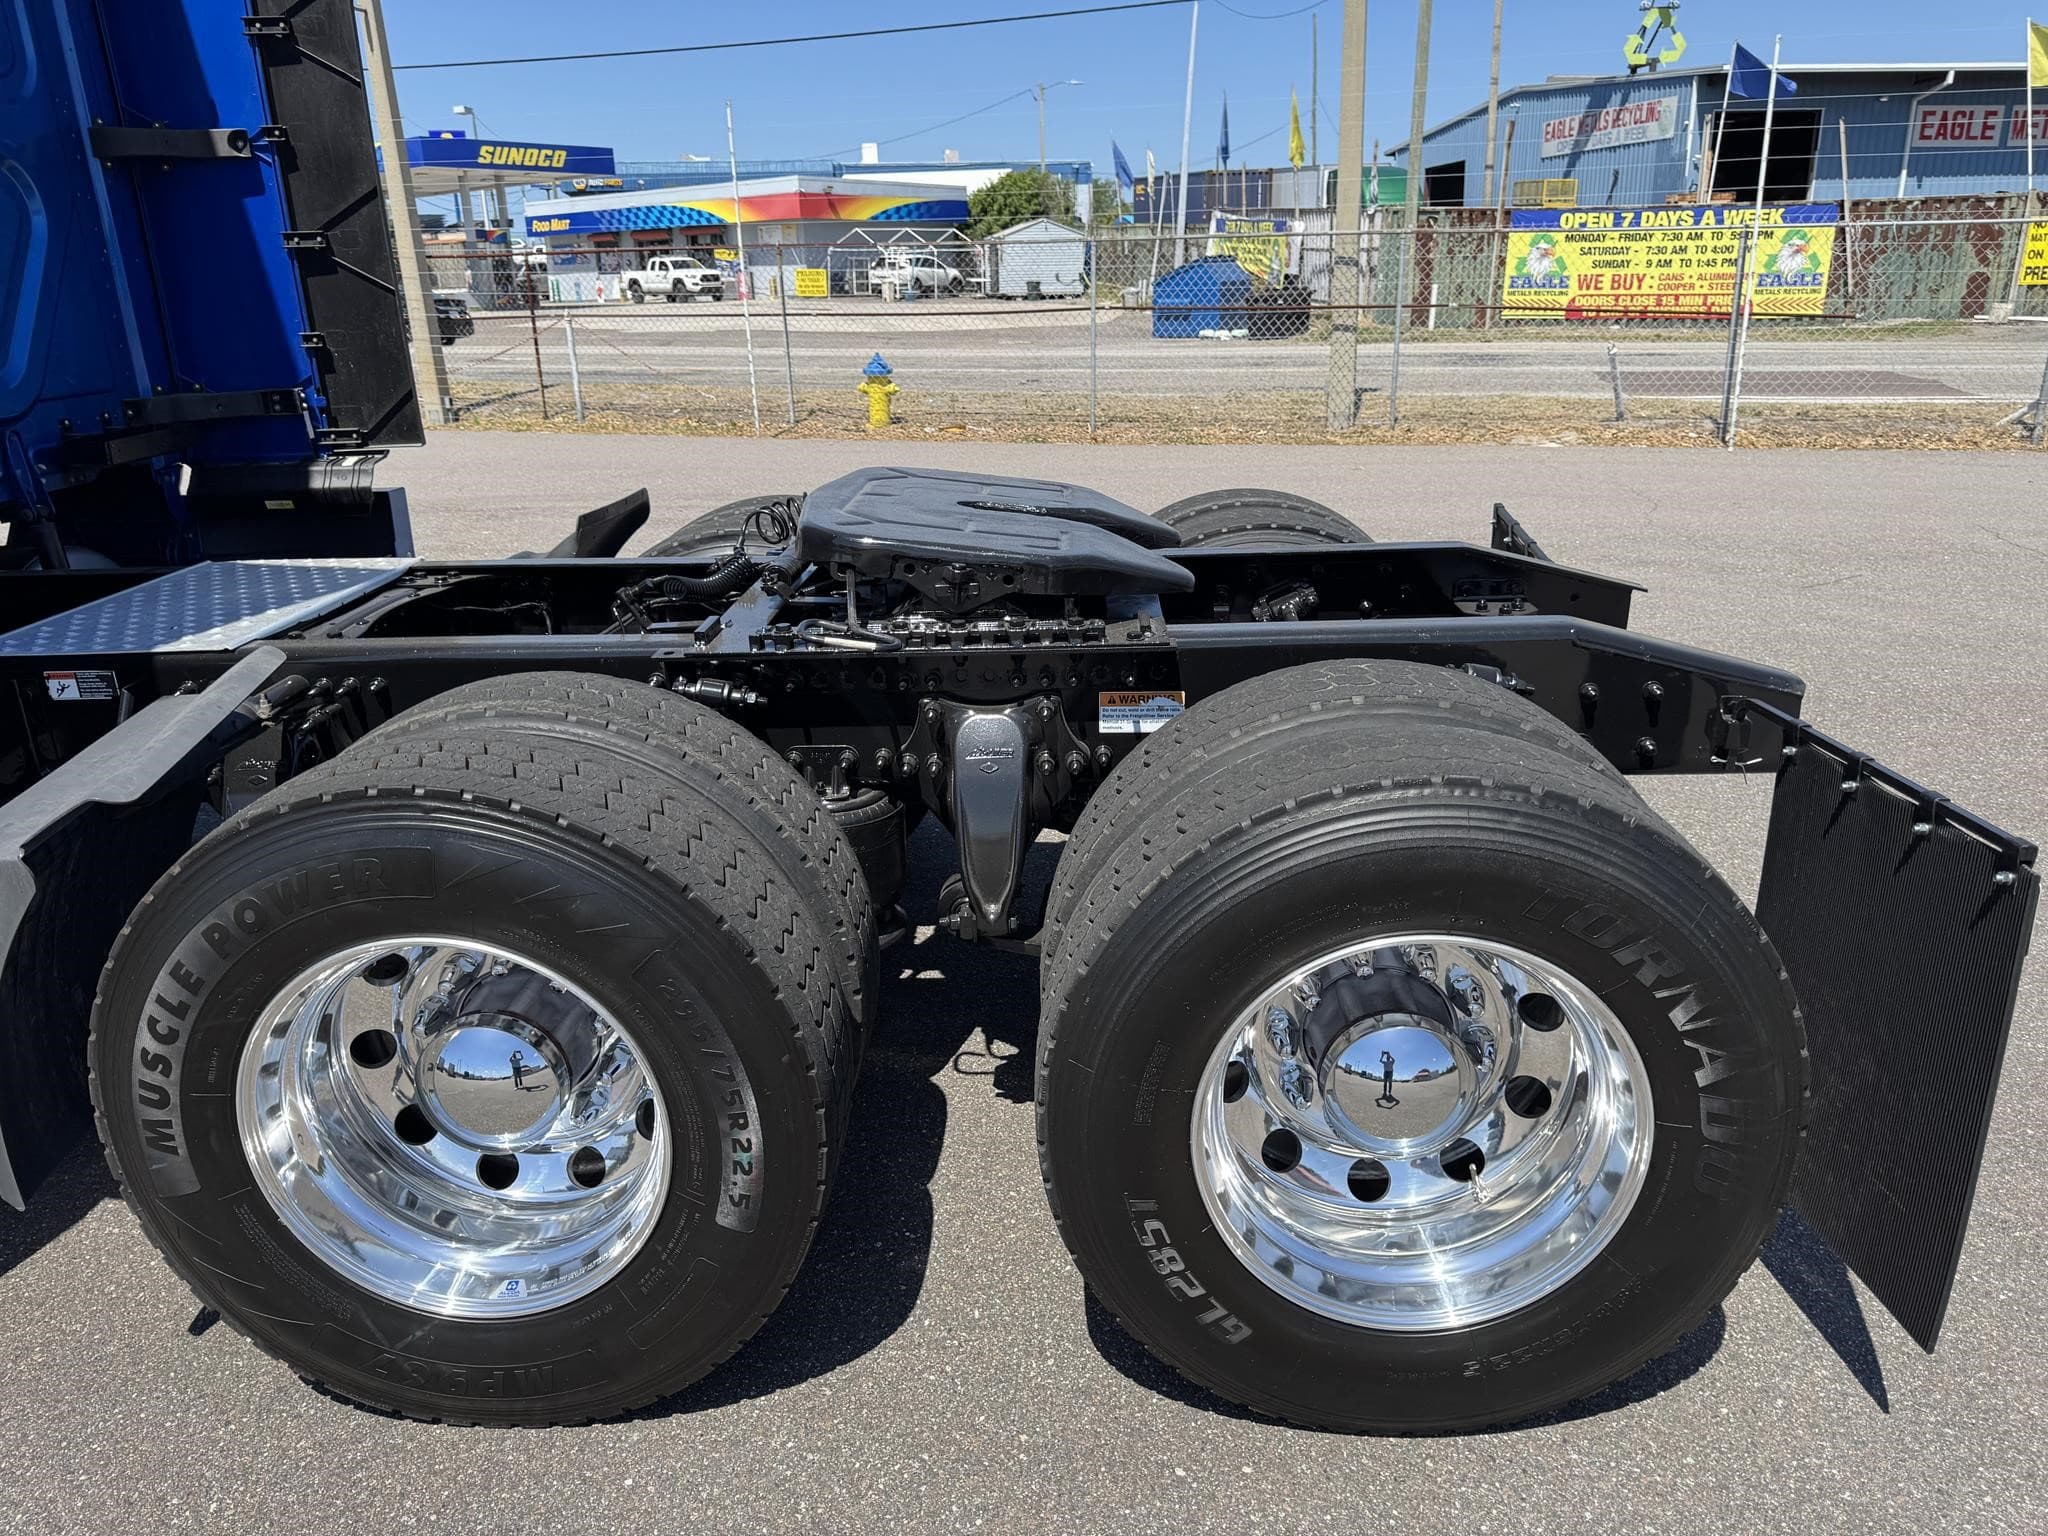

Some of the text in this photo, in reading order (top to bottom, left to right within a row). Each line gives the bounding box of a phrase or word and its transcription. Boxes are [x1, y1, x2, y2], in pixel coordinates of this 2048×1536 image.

[1544, 118, 1575, 143] EAGLE
[1611, 100, 1663, 128] RECYCLING
[1919, 110, 1999, 140] EAGLE
[477, 144, 568, 168] SUNOCO
[1559, 207, 1787, 229] OPEN 7 DAYS A WEEK
[1564, 233, 1608, 243] MONDAY
[1618, 232, 1655, 243] FRIDAY
[1661, 232, 1683, 242] 7:30
[1686, 232, 1703, 241] AM
[1711, 231, 1724, 241] TO
[1579, 246, 1632, 256] SATURDAY
[1646, 245, 1668, 255] 7:30
[1671, 245, 1688, 255] AM
[1694, 245, 1708, 254] TO
[1711, 244, 1735, 254] 4:00
[2027, 249, 2045, 261] ON
[1591, 259, 1632, 269] SUNDAY
[1645, 259, 1653, 269] 9
[1655, 258, 1673, 268] AM
[1679, 258, 1692, 268] TO
[1695, 258, 1718, 267] 1:45
[1720, 257, 1738, 267] PM
[1509, 275, 1570, 289] EAGLE
[1577, 273, 1647, 291] WE BUY
[1658, 273, 1685, 282] CANS
[1756, 272, 1825, 287] EAGLE
[1657, 282, 1738, 291] COOPER STEE
[1575, 295, 1745, 306] DOORS CLOSE 15 MIN PRIO
[138, 857, 393, 1158] MUSCLE POWER
[1521, 876, 1745, 1192] TORNADO
